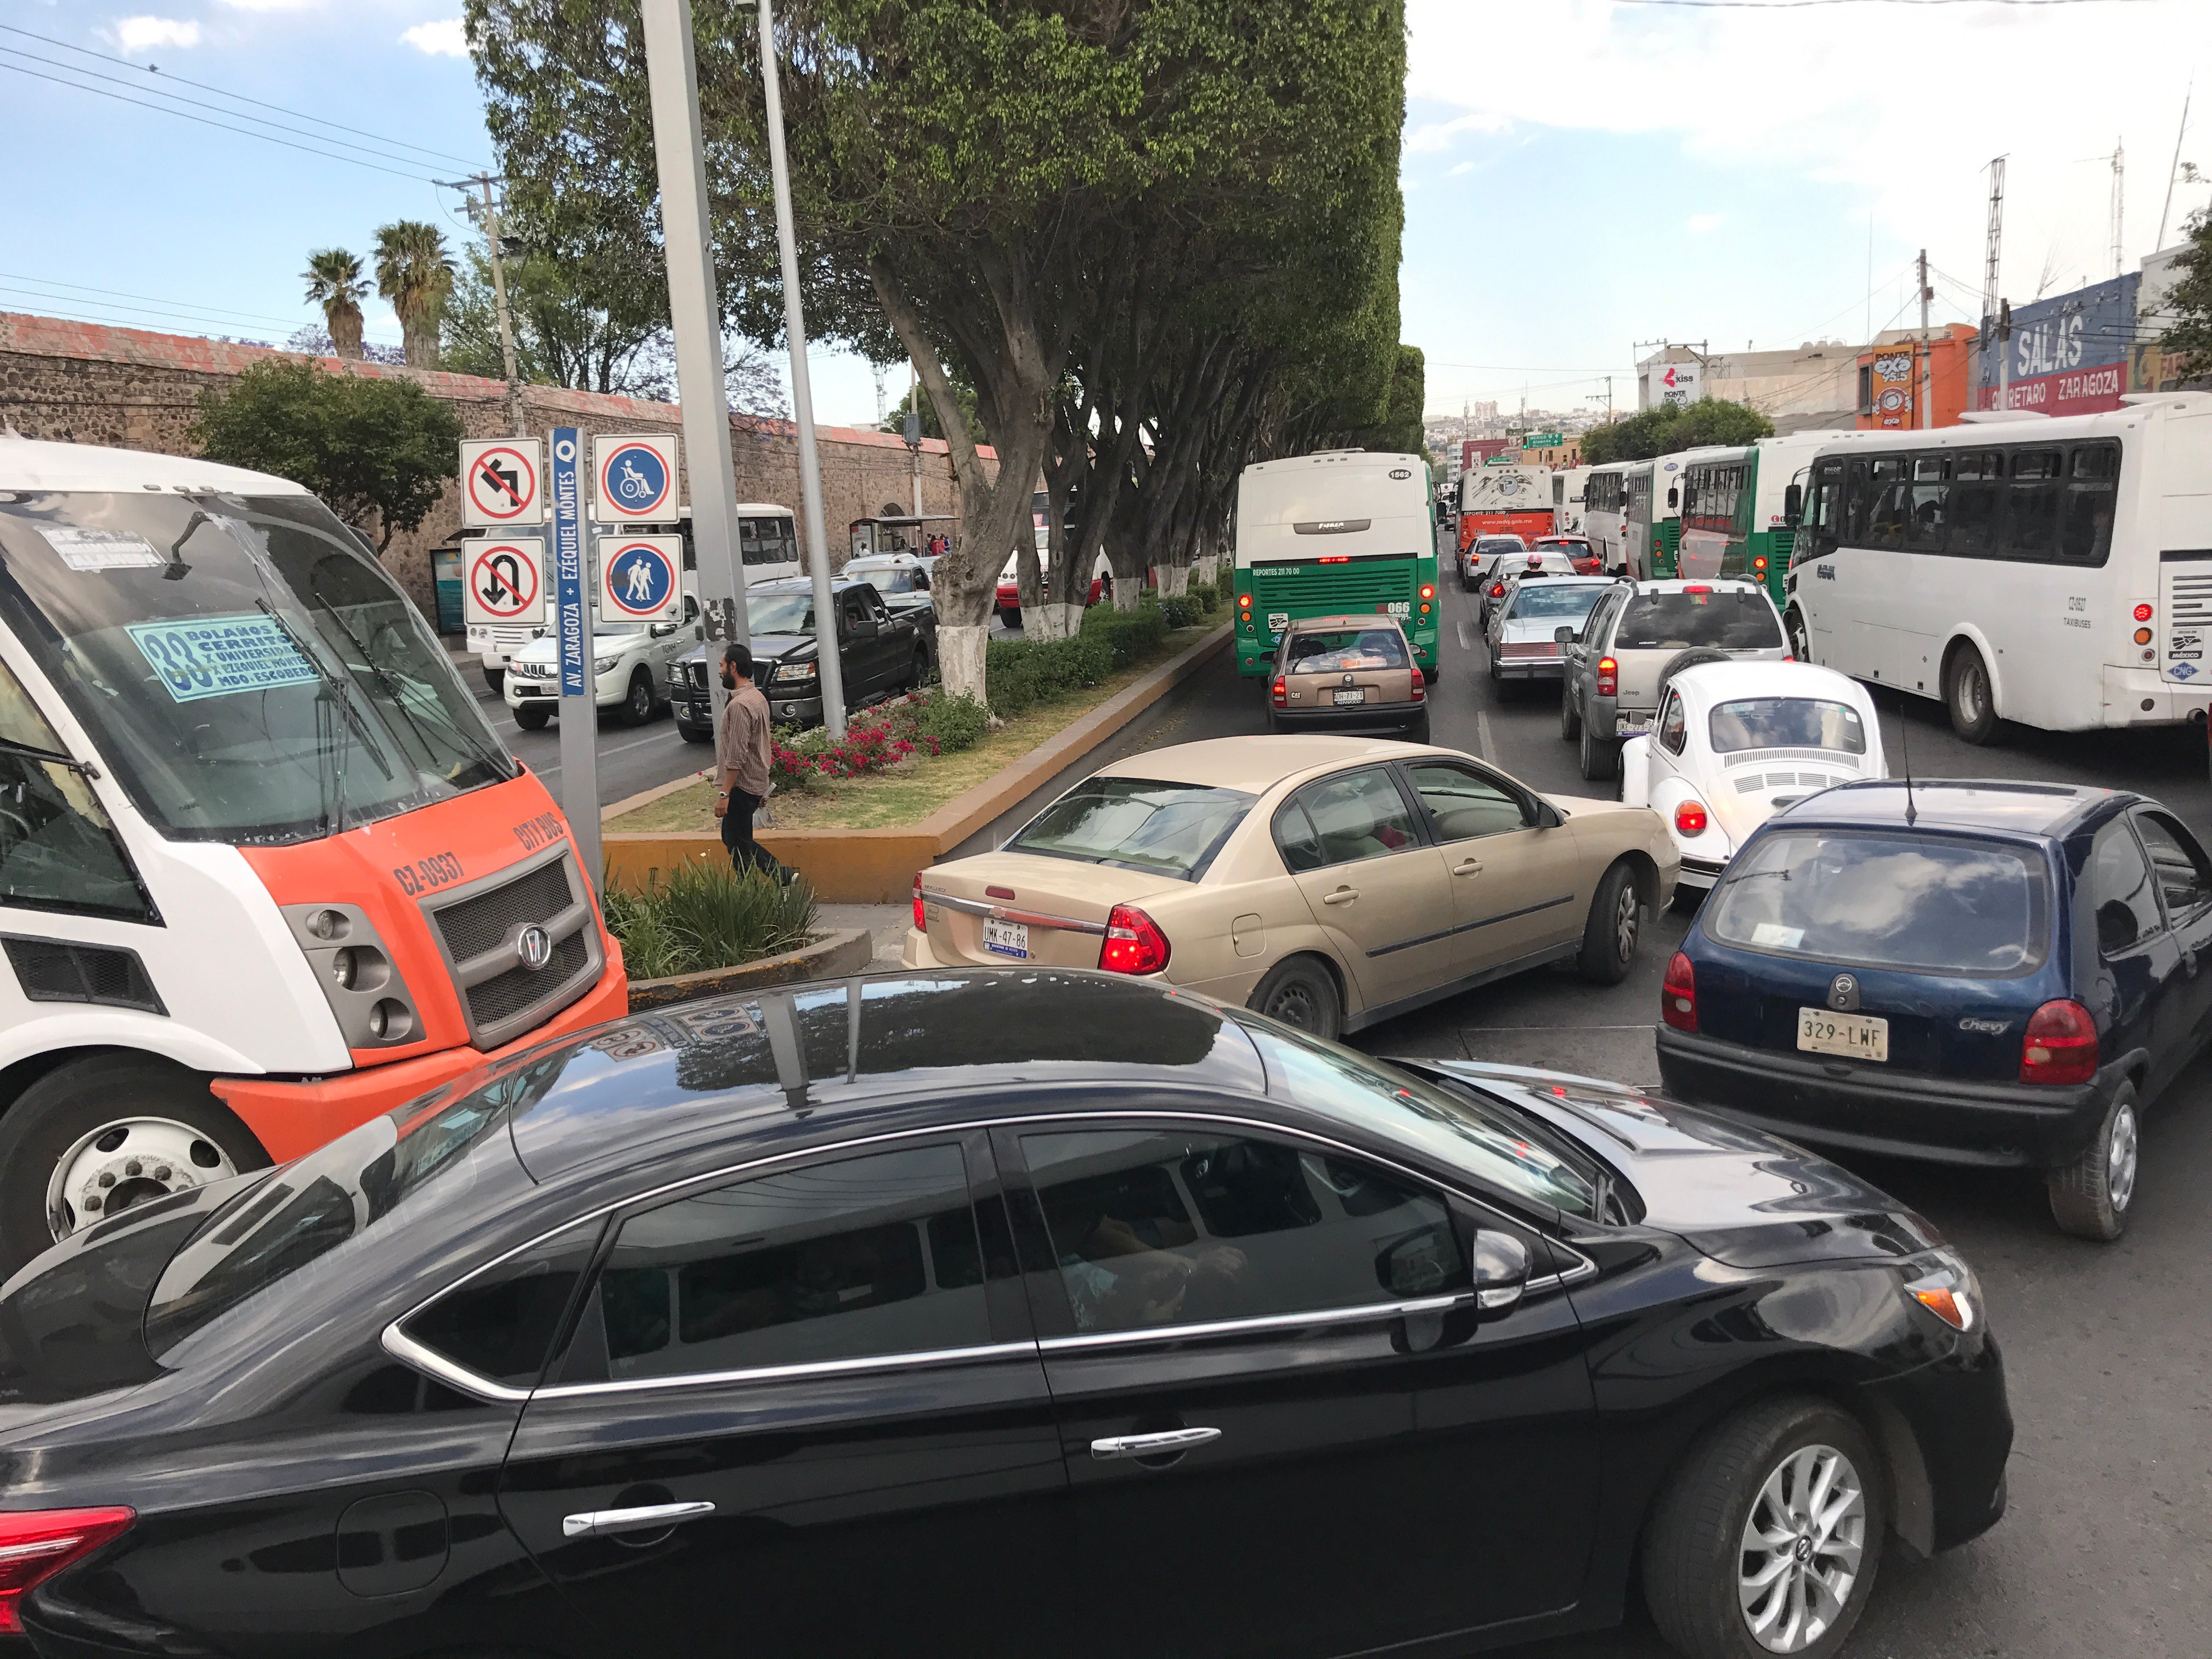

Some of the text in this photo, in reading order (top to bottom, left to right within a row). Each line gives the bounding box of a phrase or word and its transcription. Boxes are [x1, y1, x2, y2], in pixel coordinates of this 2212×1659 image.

[2017, 315, 2083, 376] SALAS
[1882, 373, 1908, 382] 95.5
[1991, 369, 2119, 410] QURETARO ZARAGOZA
[559, 471, 576, 520] MONTES
[561, 523, 578, 580] EZEQUIEL
[1252, 568, 1277, 576] REPORTES
[1293, 567, 1300, 575] 00
[1388, 601, 1410, 613] 066
[184, 625, 273, 641] BOLAÑOS
[2063, 617, 2091, 629] TAXIBUSES
[564, 602, 582, 666] ZARAGOZA
[144, 632, 213, 691] 33
[224, 661, 272, 673] EZEQUIEL
[2174, 667, 2192, 676] CNG
[257, 666, 318, 682] ESCOBEDO
[566, 669, 582, 688] AV.
[513, 812, 564, 851] CITY BUS
[393, 851, 465, 896] CZ-0937
[984, 926, 1025, 949] UMK-47-86
[1804, 1020, 1881, 1047] 329-LWF
[1958, 1017, 2013, 1036] Chevy
